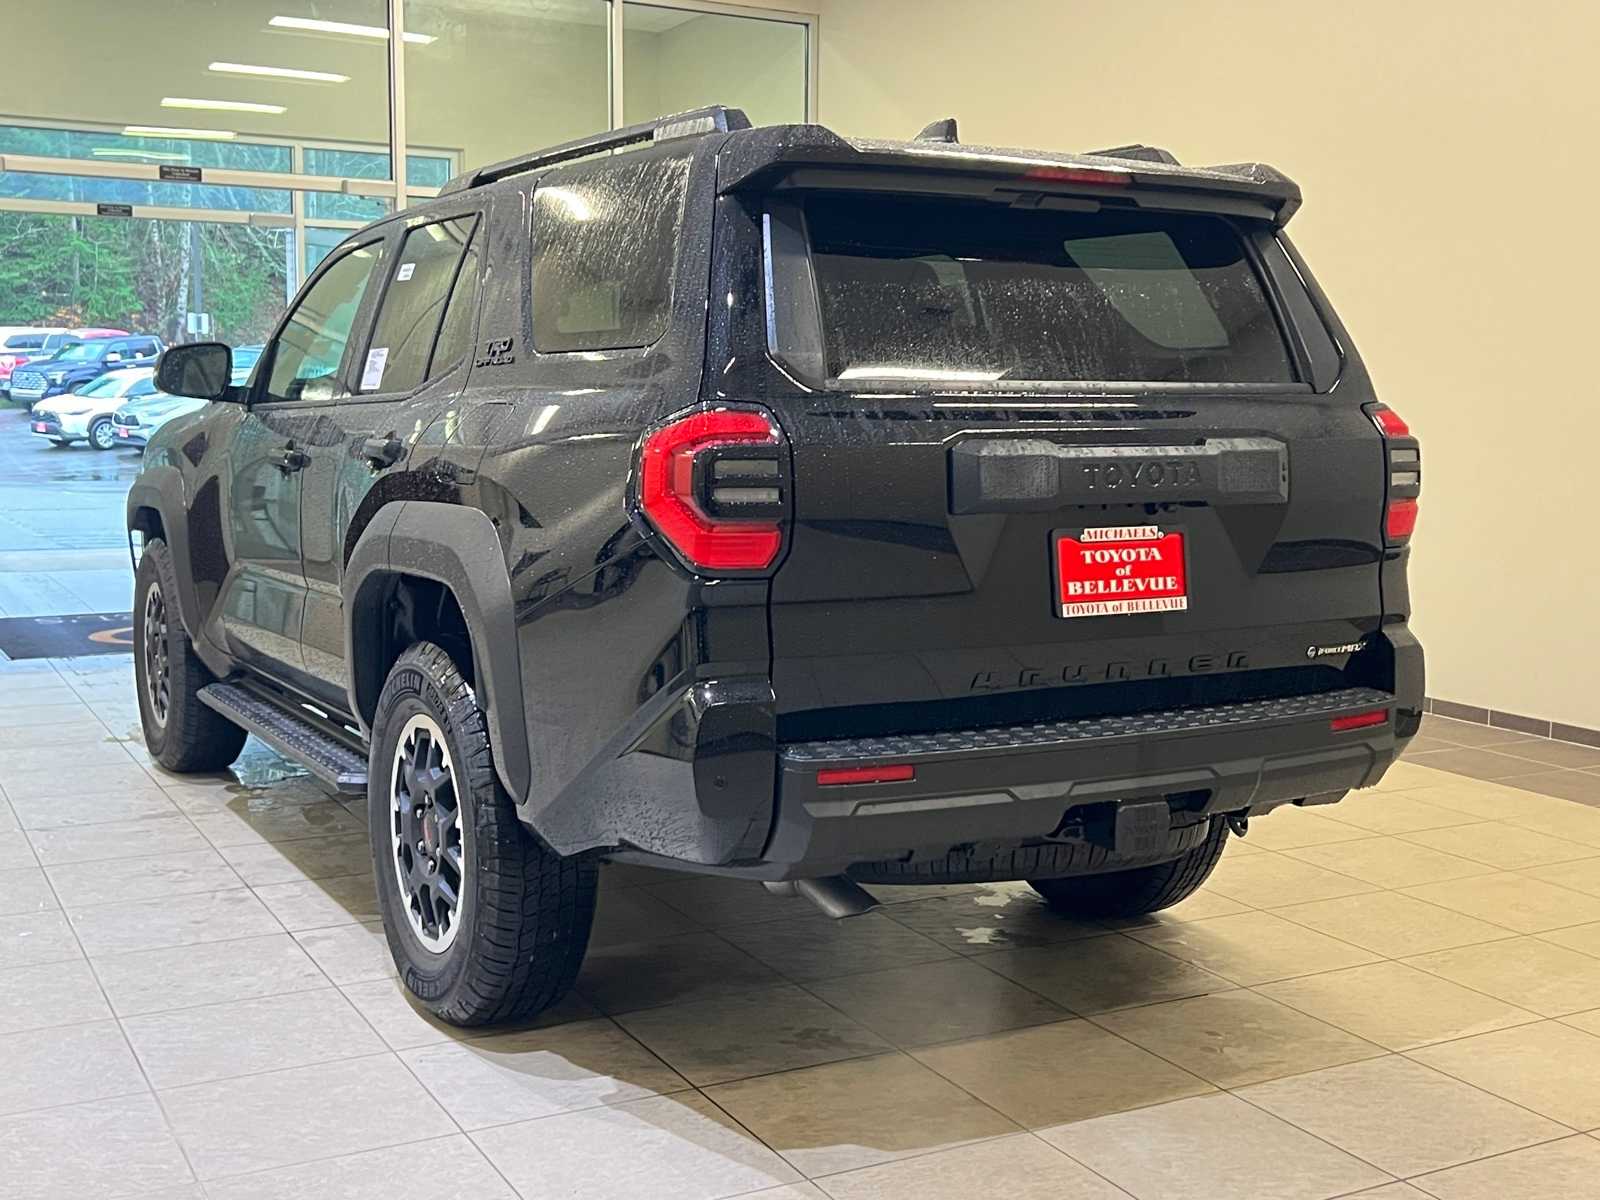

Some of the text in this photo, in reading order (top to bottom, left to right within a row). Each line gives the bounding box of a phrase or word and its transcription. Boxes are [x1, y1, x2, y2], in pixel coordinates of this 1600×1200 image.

[1081, 461, 1201, 489] TOYOTA
[1084, 527, 1156, 541] MICHAELS
[1080, 547, 1162, 564] TOYOTA
[1115, 564, 1133, 577] of
[1067, 576, 1177, 596] BELLEVUE
[1065, 597, 1185, 616] TOYOTA of BELLEVUE
